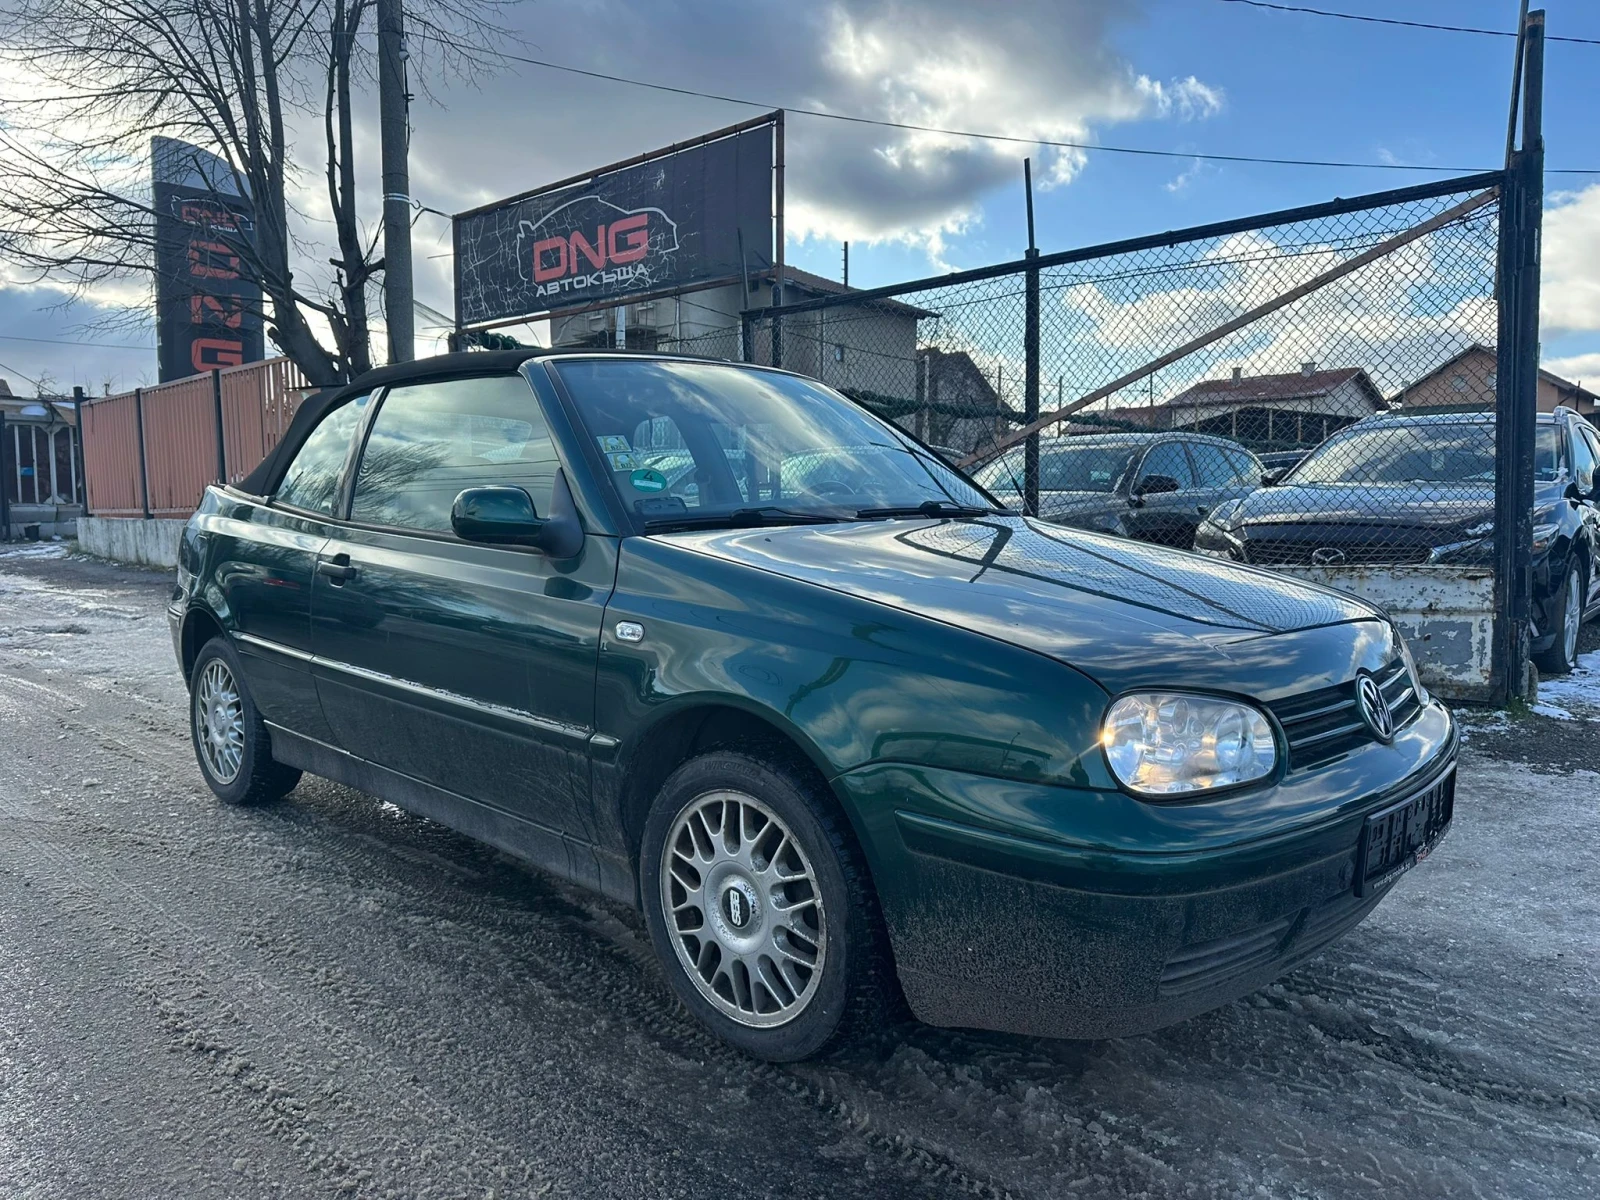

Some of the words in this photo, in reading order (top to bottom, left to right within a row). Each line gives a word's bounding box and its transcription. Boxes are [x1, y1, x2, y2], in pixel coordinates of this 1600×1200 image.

[533, 214, 648, 283] DNG
[643, 470, 653, 481] 4
[729, 889, 742, 926] BBS
